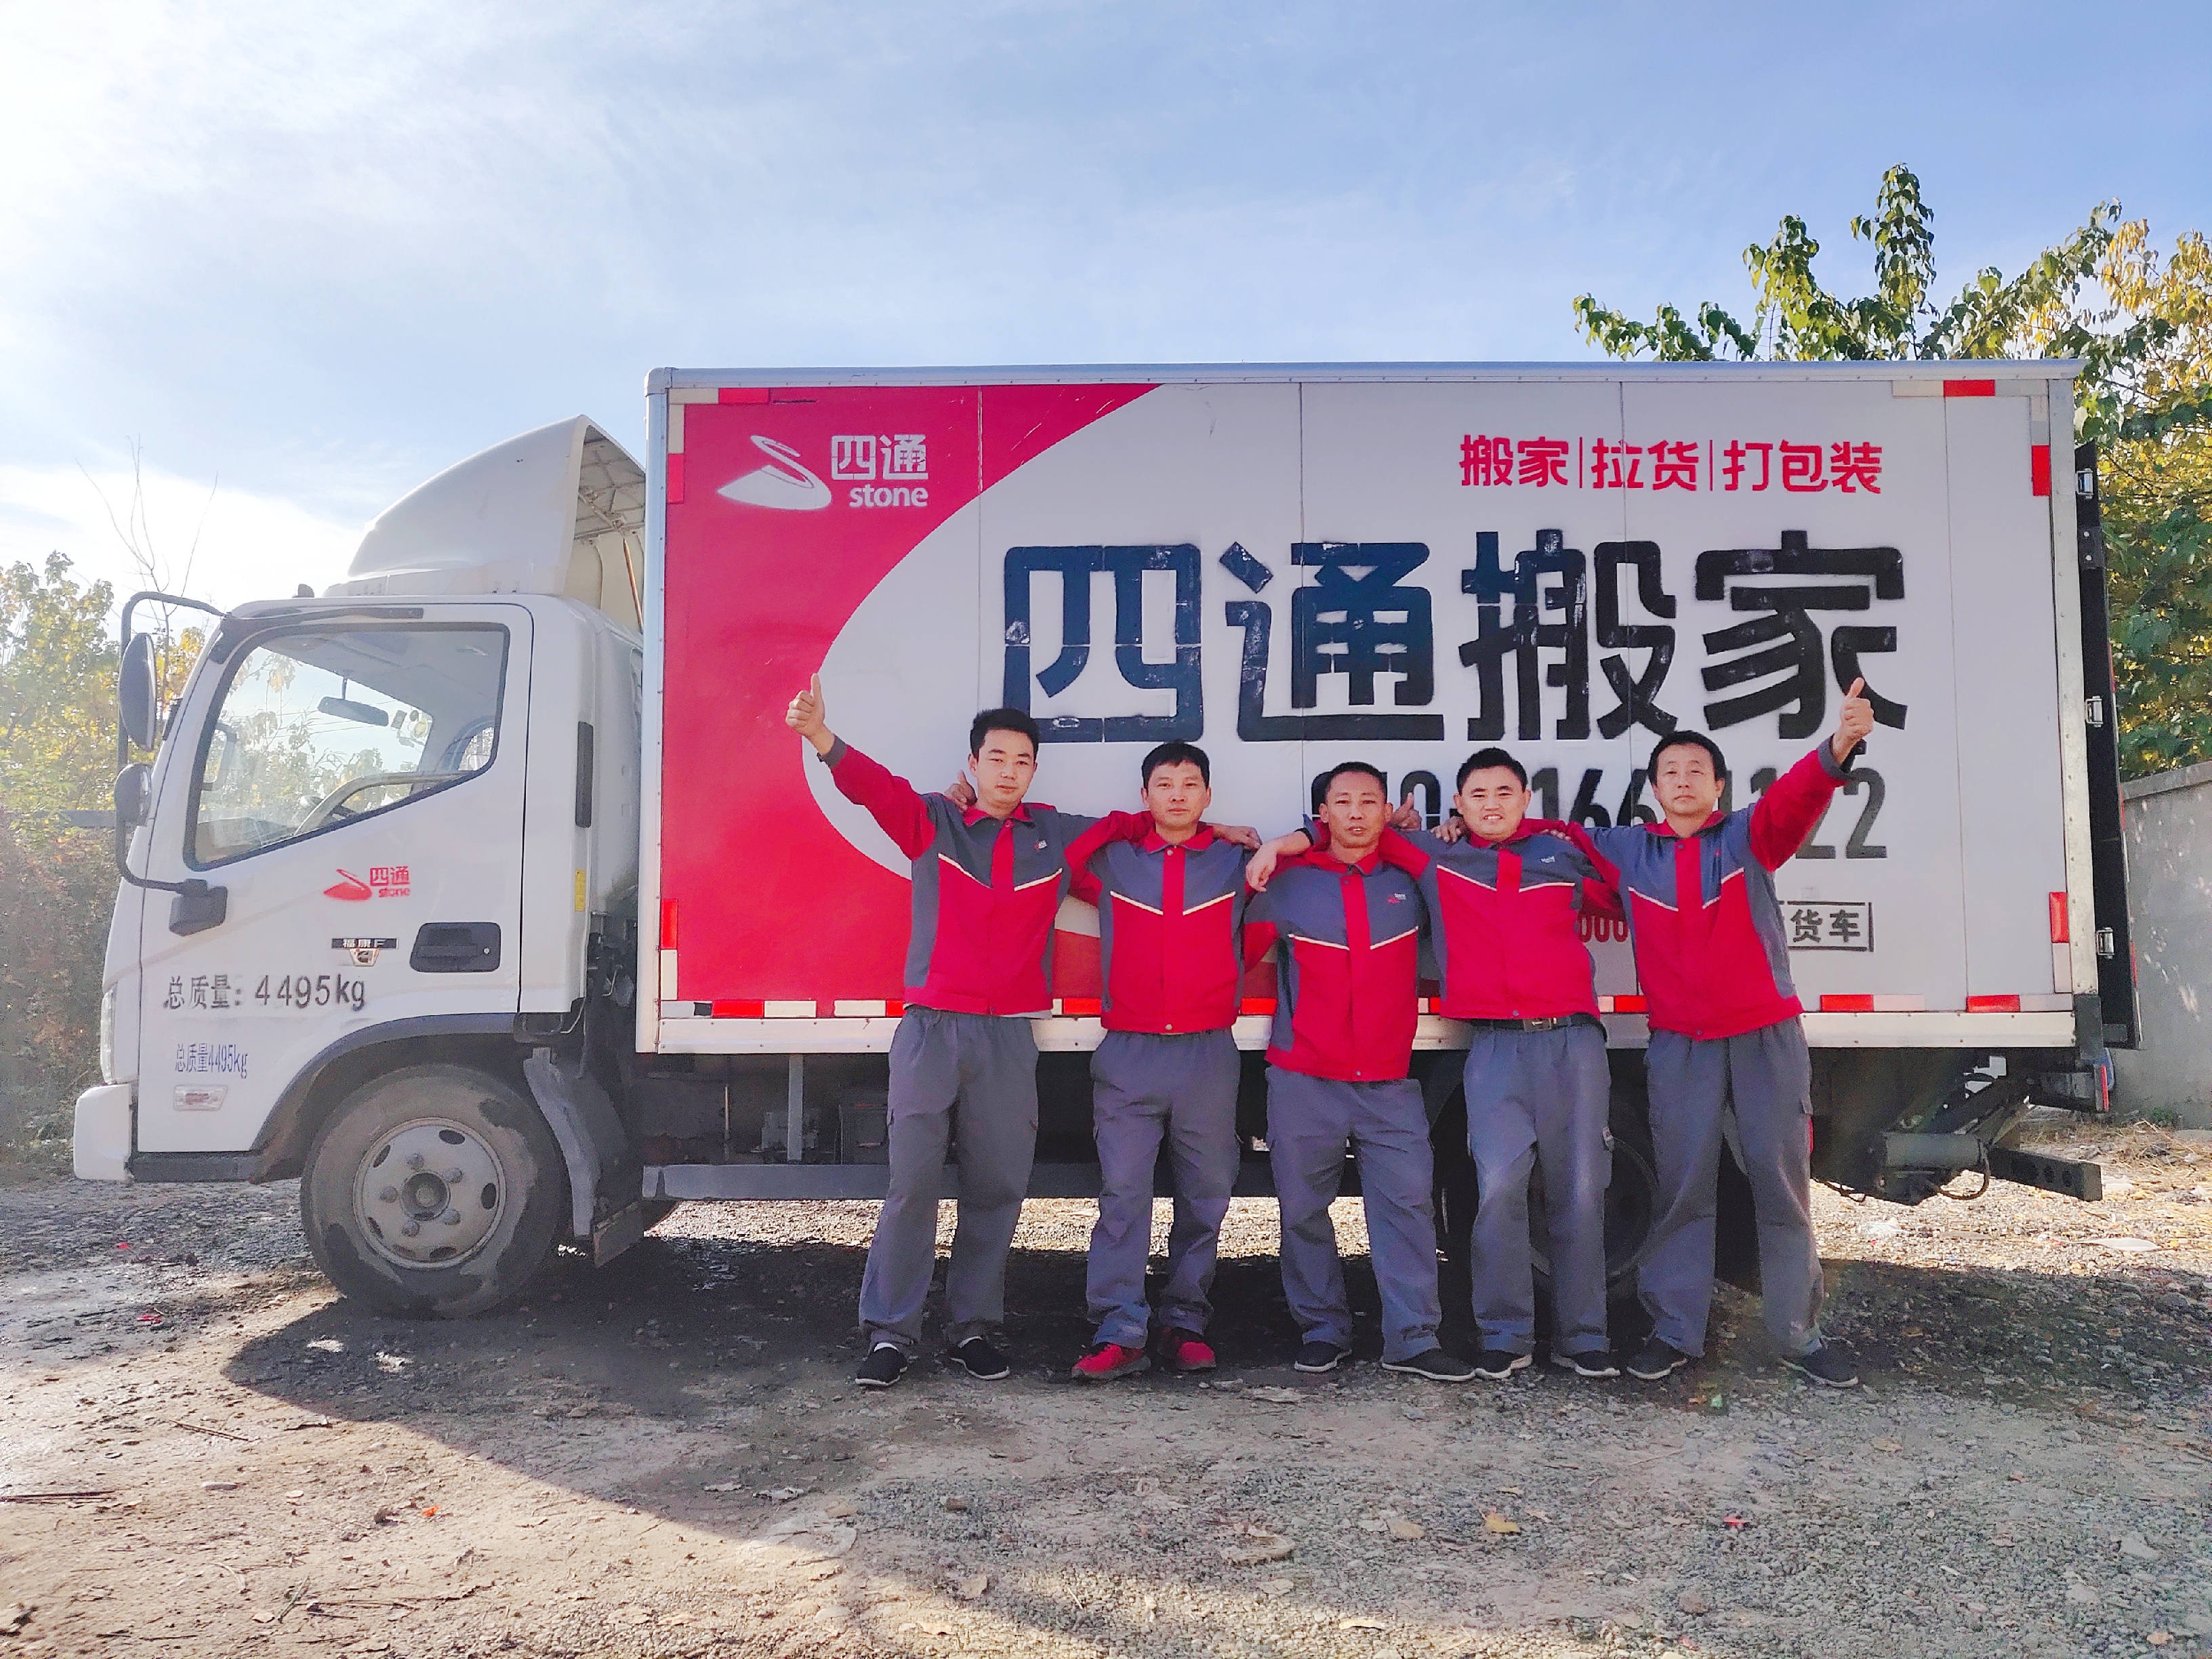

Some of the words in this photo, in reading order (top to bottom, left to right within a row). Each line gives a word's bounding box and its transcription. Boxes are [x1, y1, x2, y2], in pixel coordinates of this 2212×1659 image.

[831, 434, 928, 480] 四通
[849, 483, 928, 507] stone
[1004, 529, 1908, 743] 四通搬家
[369, 865, 410, 886] 四通
